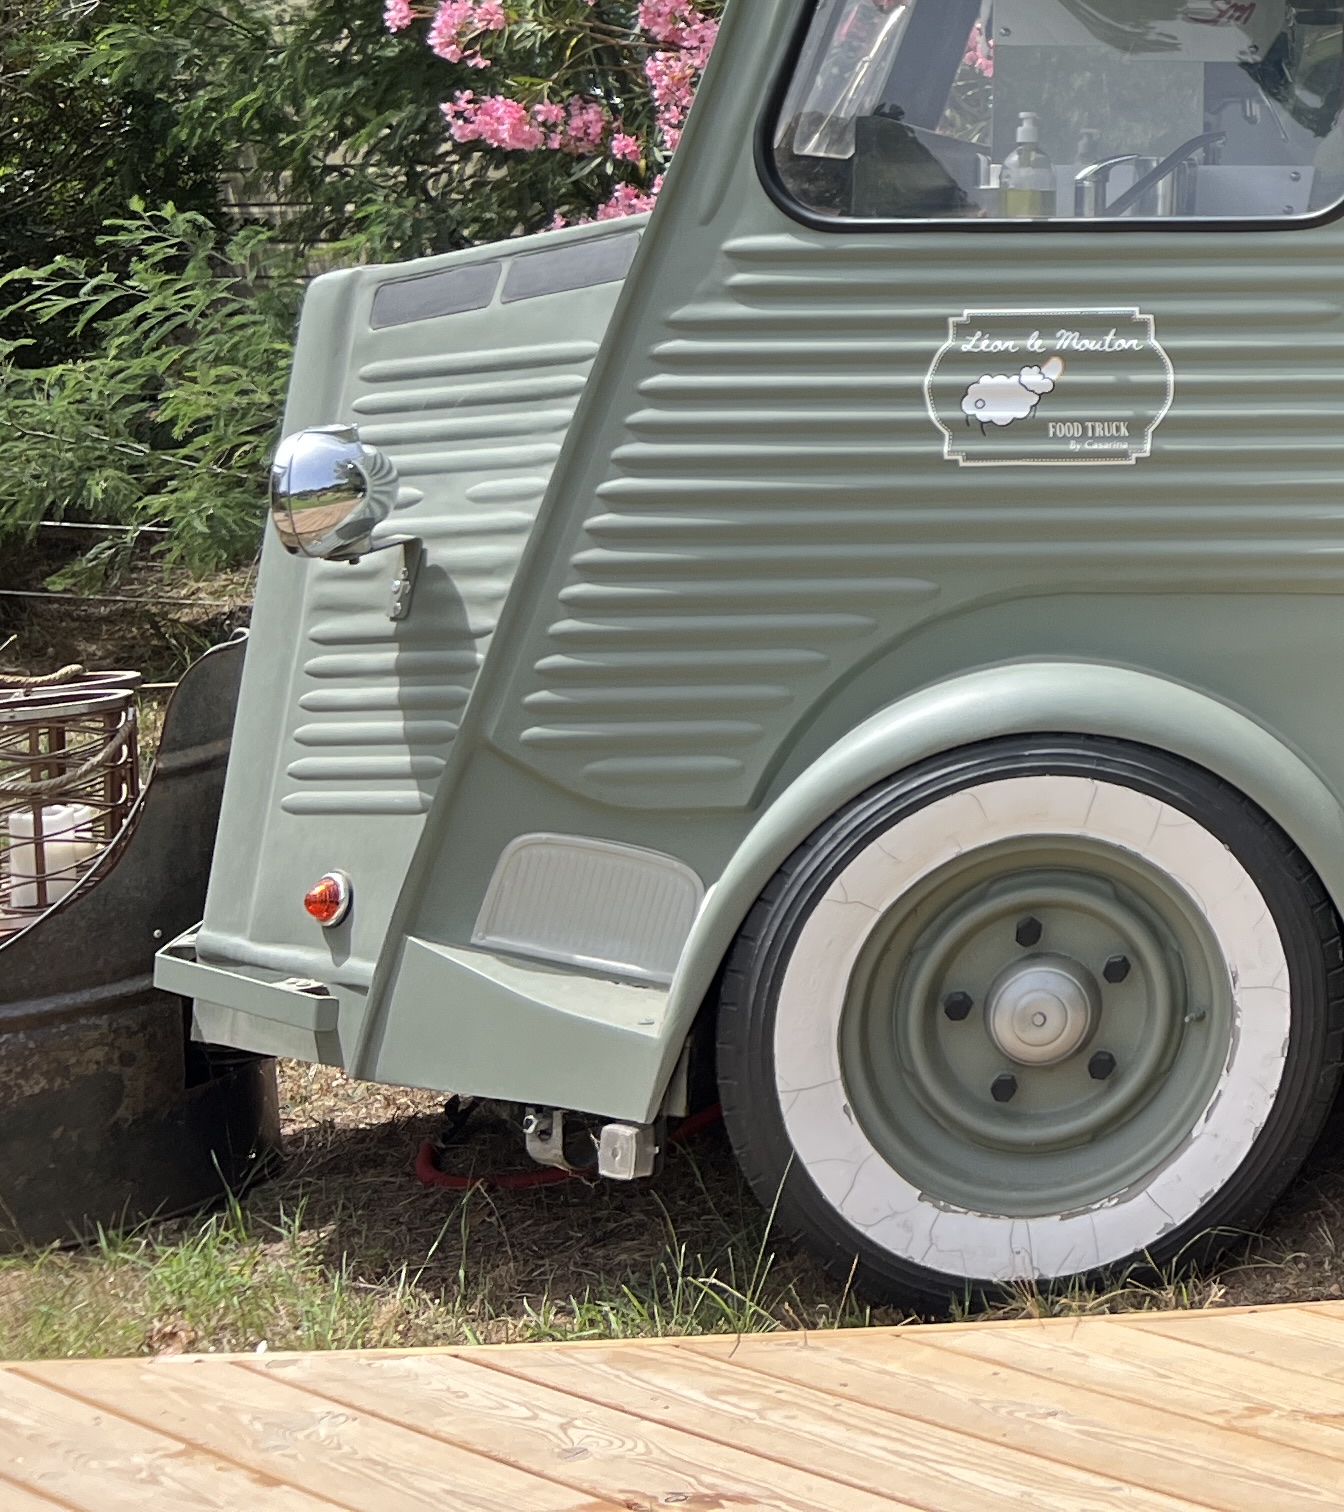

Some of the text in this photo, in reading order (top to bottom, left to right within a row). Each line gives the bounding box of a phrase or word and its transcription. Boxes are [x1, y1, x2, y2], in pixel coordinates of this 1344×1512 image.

[961, 328, 1144, 353] Léon le Mouton
[1048, 421, 1130, 438] FOOD TRUCK
[1069, 440, 1081, 452] By
